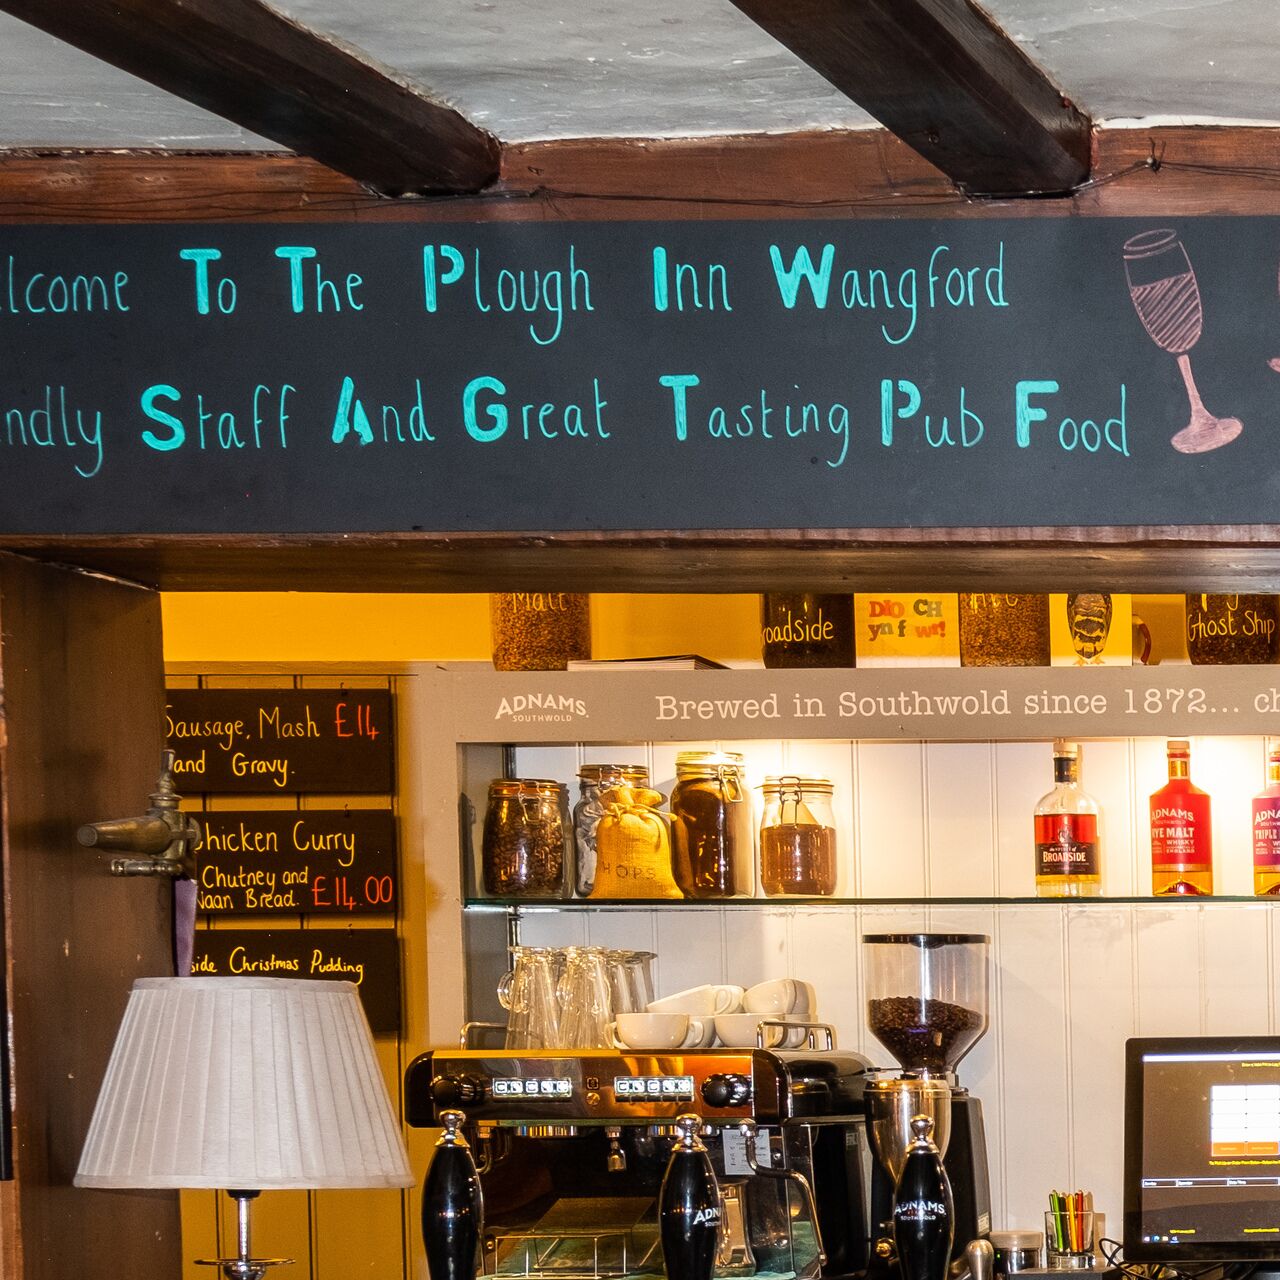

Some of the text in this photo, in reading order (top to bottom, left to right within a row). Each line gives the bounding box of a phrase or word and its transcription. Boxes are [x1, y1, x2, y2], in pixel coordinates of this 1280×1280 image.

[180, 248, 238, 315] To
[275, 246, 364, 314] The
[423, 243, 594, 345] Plough
[652, 246, 733, 312] Inn
[768, 241, 1009, 344] Wangford
[141, 383, 297, 451] Staff
[331, 375, 435, 445] And
[462, 375, 610, 443] Great
[658, 373, 850, 468] Tasting
[880, 378, 985, 448] Pub
[1015, 380, 1130, 458] Food
[1187, 611, 1276, 645] Ghost Ship
[513, 715, 572, 723] SOUTHWOLD
[655, 693, 781, 720] Brewed
[794, 692, 826, 717] in
[838, 688, 1011, 717] Southwold
[1024, 689, 1107, 715] since
[1125, 687, 1239, 714] 1872...
[259, 705, 320, 739] Mash
[335, 703, 380, 741] £14
[173, 750, 295, 787] and Gravy.
[196, 820, 356, 867] hicken Curry
[1166, 827, 1194, 838] MALT
[1255, 829, 1277, 839] TRIPLE
[601, 862, 657, 881] HOPS
[1043, 851, 1086, 863] BROADSIDE
[202, 865, 393, 910] Chutney and £14.00
[246, 888, 300, 910] Bread.
[229, 947, 363, 985] Christmas Pudding
